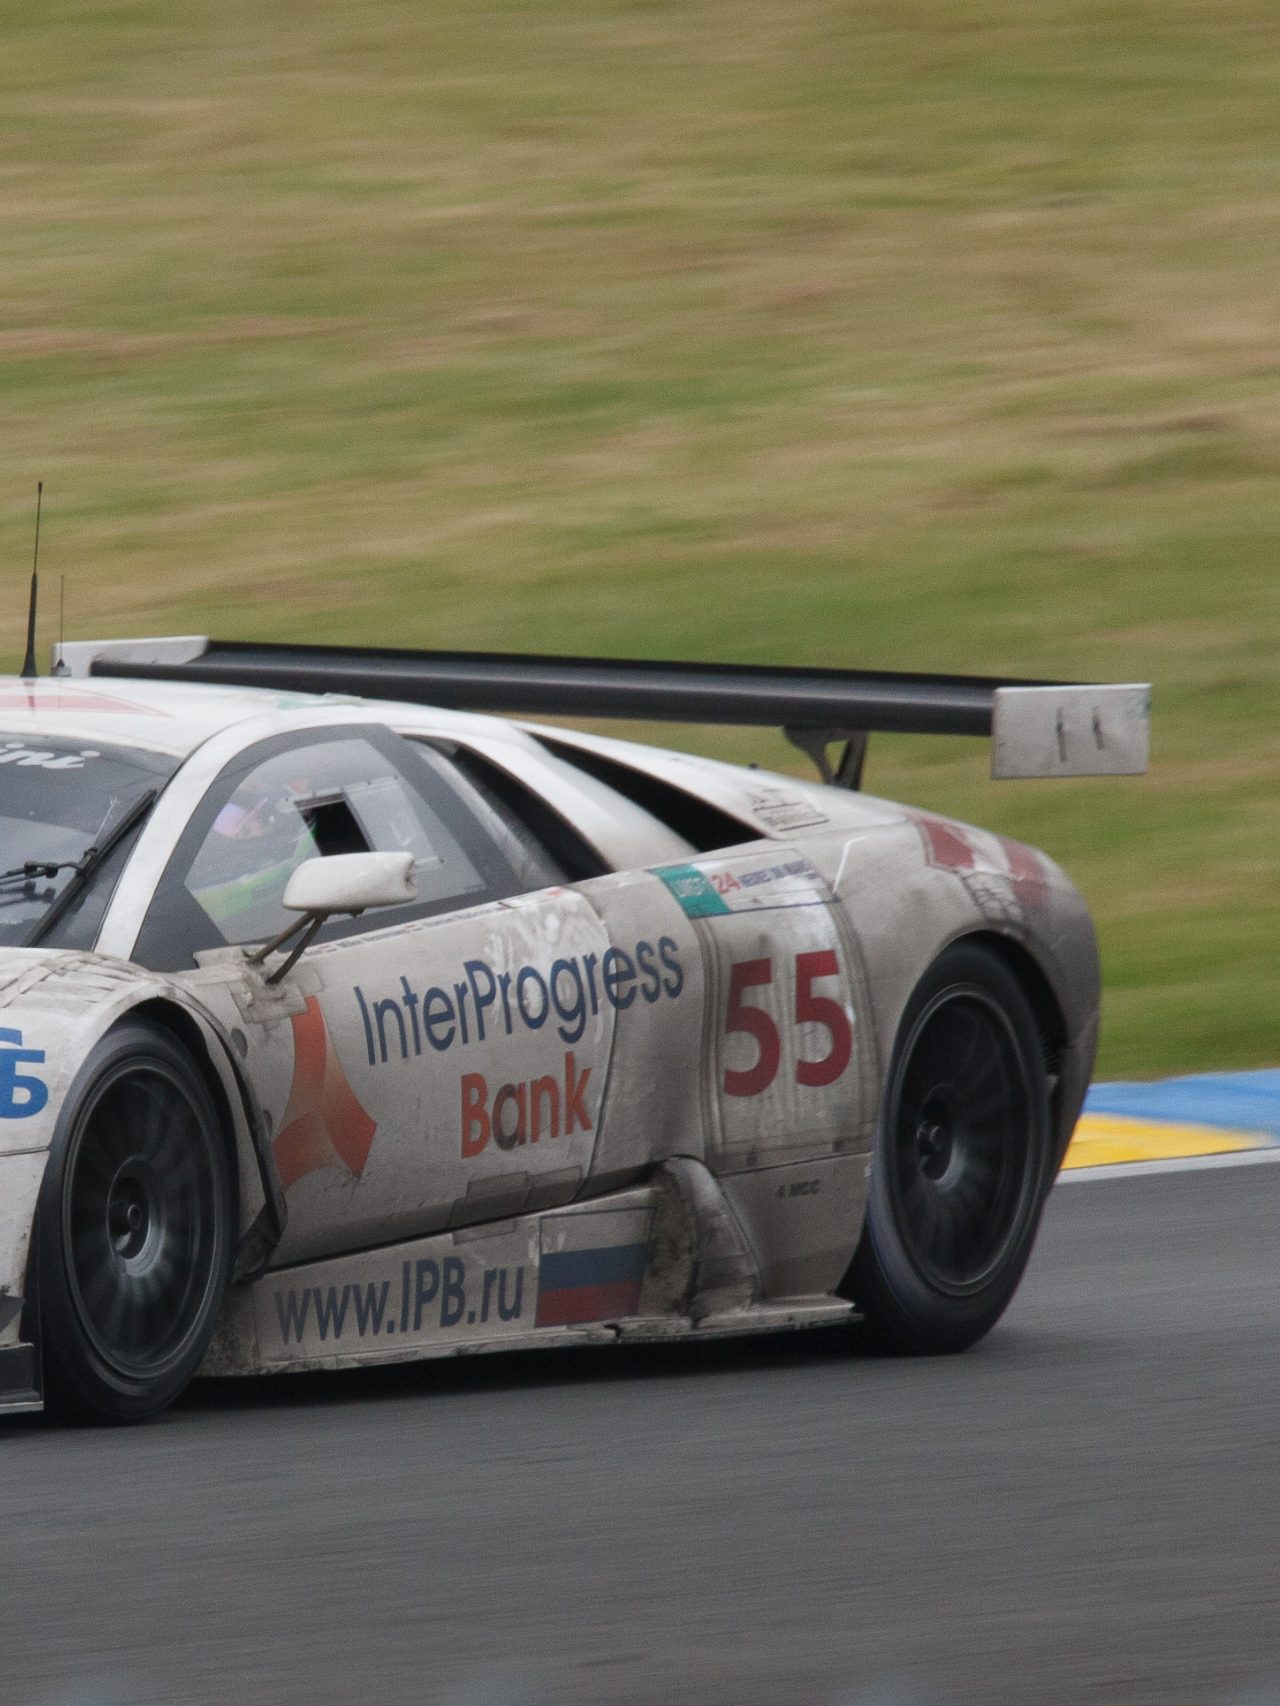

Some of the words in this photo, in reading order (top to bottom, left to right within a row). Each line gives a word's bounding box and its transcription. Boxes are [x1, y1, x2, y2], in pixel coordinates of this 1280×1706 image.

[354, 935, 685, 1066] InterProgress
[723, 949, 852, 1098] 55
[460, 1051, 593, 1160] Bank
[275, 1254, 524, 1346] www.IPB.ru
